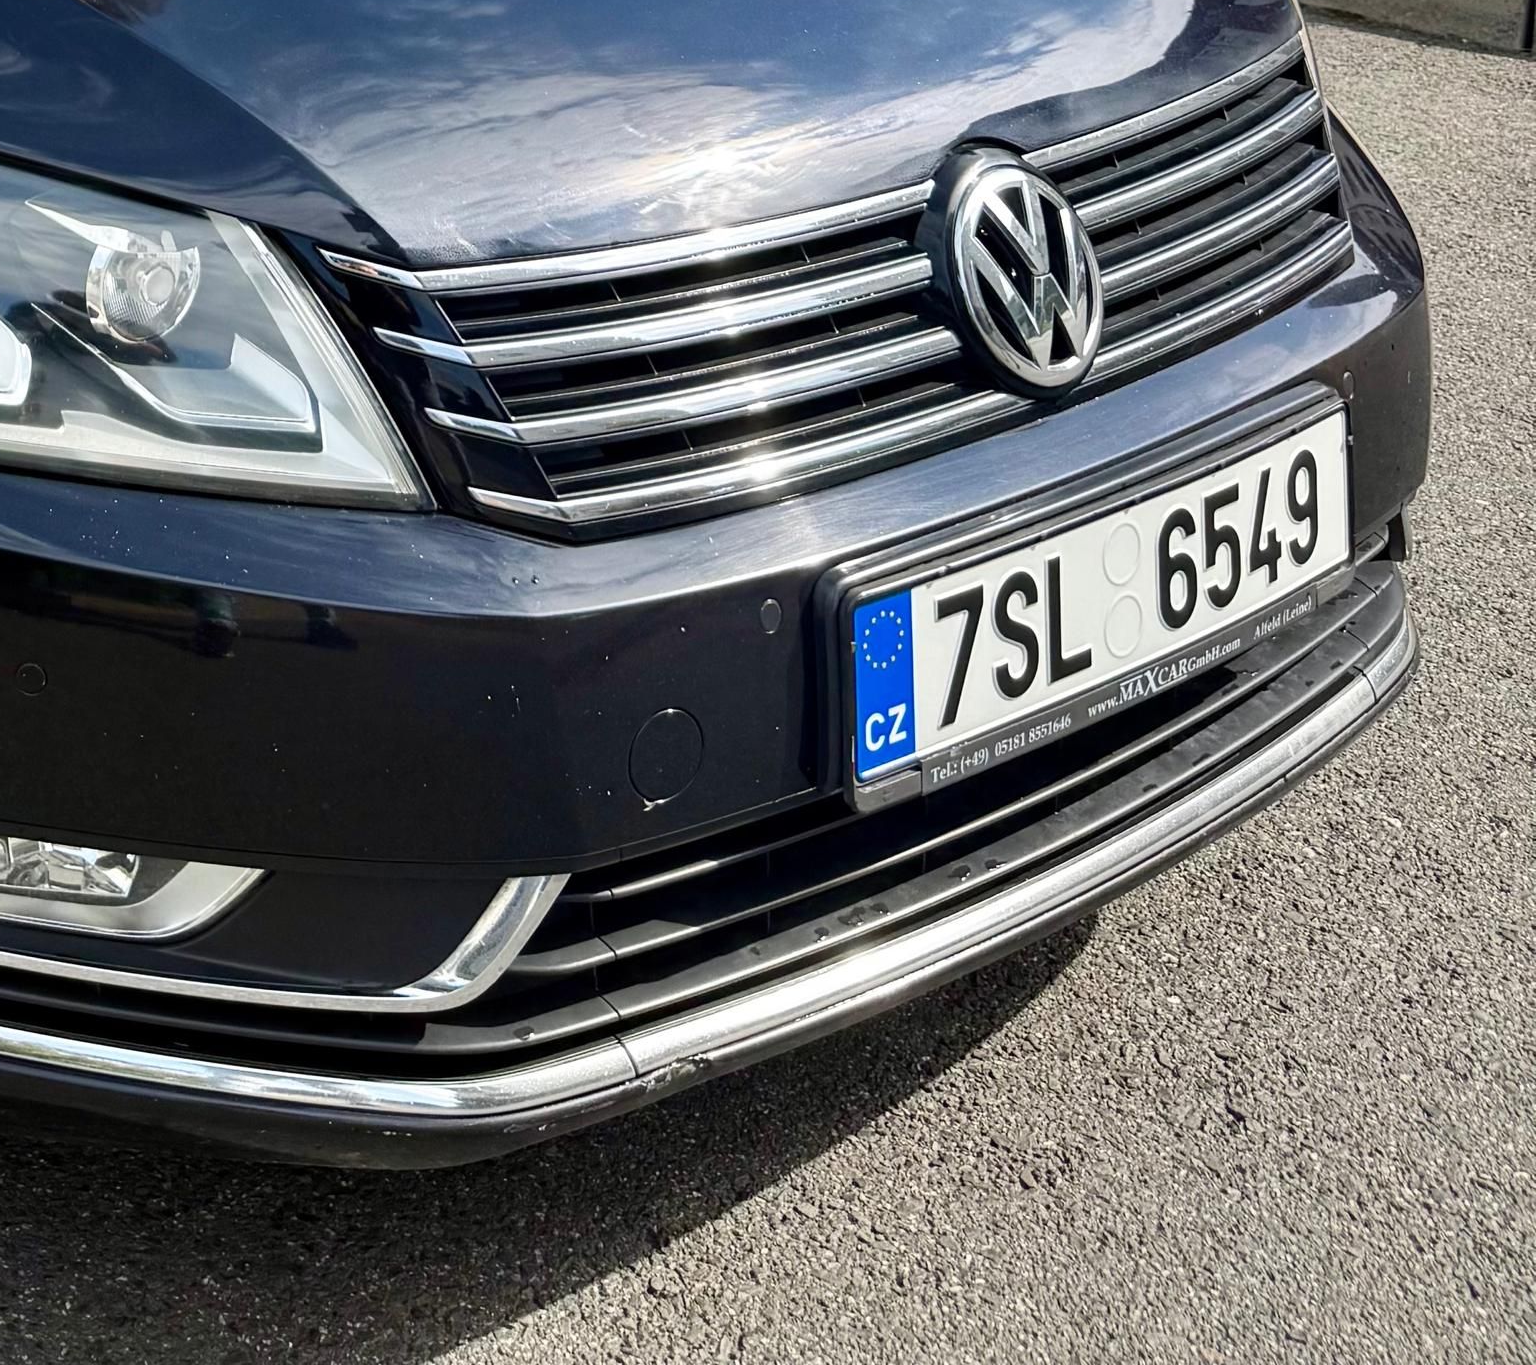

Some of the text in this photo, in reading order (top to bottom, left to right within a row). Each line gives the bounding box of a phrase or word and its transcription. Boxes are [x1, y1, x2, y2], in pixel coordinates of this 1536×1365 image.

[961, 165, 1096, 377] VW
[930, 762, 958, 783] Tel.:
[960, 747, 989, 774] (+49)
[994, 732, 1026, 757] 05181
[1028, 712, 1072, 743] 8551646
[1253, 612, 1282, 640] Alfeld
[1282, 594, 1312, 625] (Leine)
[936, 448, 1319, 730] 7SL 6549
[865, 702, 907, 752] CZ
